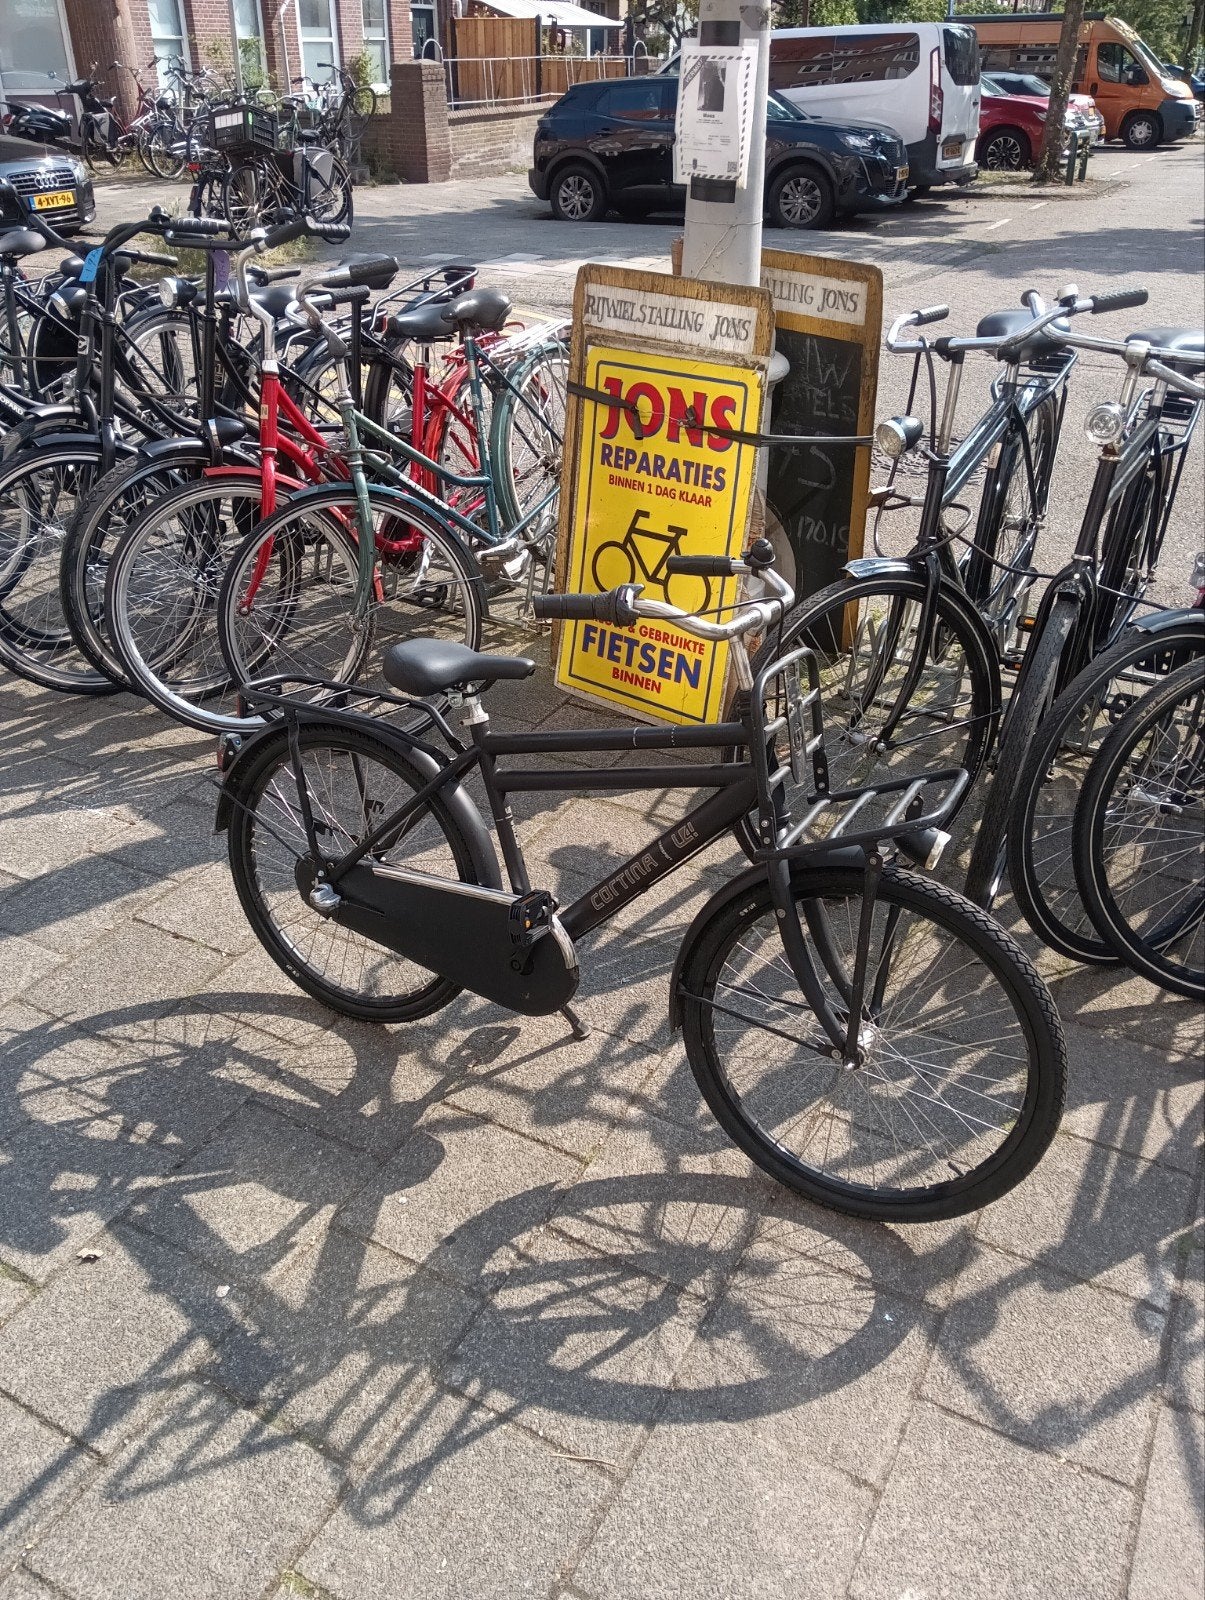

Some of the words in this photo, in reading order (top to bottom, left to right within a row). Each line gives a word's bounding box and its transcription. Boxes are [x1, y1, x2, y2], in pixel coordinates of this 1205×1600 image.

[585, 294, 705, 333] RIJWIELSTALLING
[708, 314, 752, 342] JONS
[817, 287, 860, 313] JONS
[599, 376, 737, 453] JONS
[600, 443, 727, 492] REPARATIES
[608, 474, 645, 493] BINNEN
[647, 483, 653, 494] 1
[655, 485, 677, 500] DAG
[678, 490, 712, 507] KLAAR
[581, 623, 702, 689] FIETSEN
[638, 625, 706, 655] GEBRUIKTE
[612, 667, 662, 693] BINNEN
